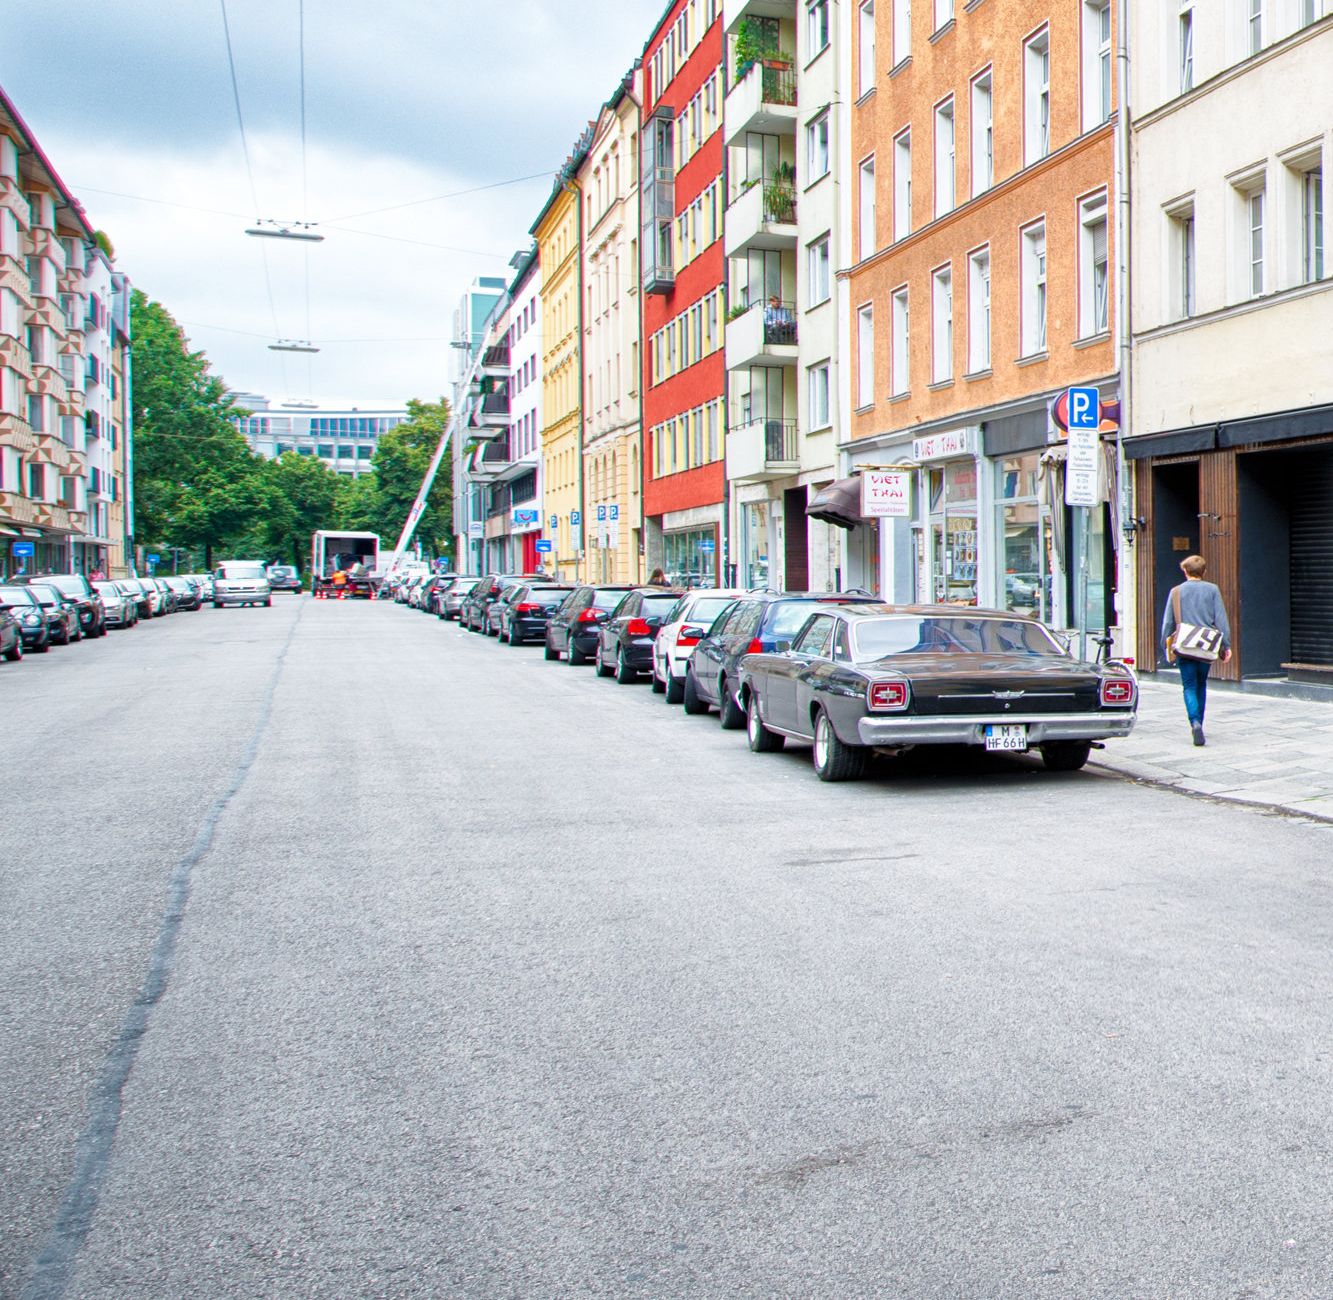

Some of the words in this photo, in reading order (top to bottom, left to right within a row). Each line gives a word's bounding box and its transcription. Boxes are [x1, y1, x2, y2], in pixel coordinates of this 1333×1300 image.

[1073, 392, 1090, 423] P
[871, 475, 902, 485] VIET
[872, 488, 903, 498] THAI
[1001, 726, 1010, 736] M
[988, 738, 1001, 748] HF
